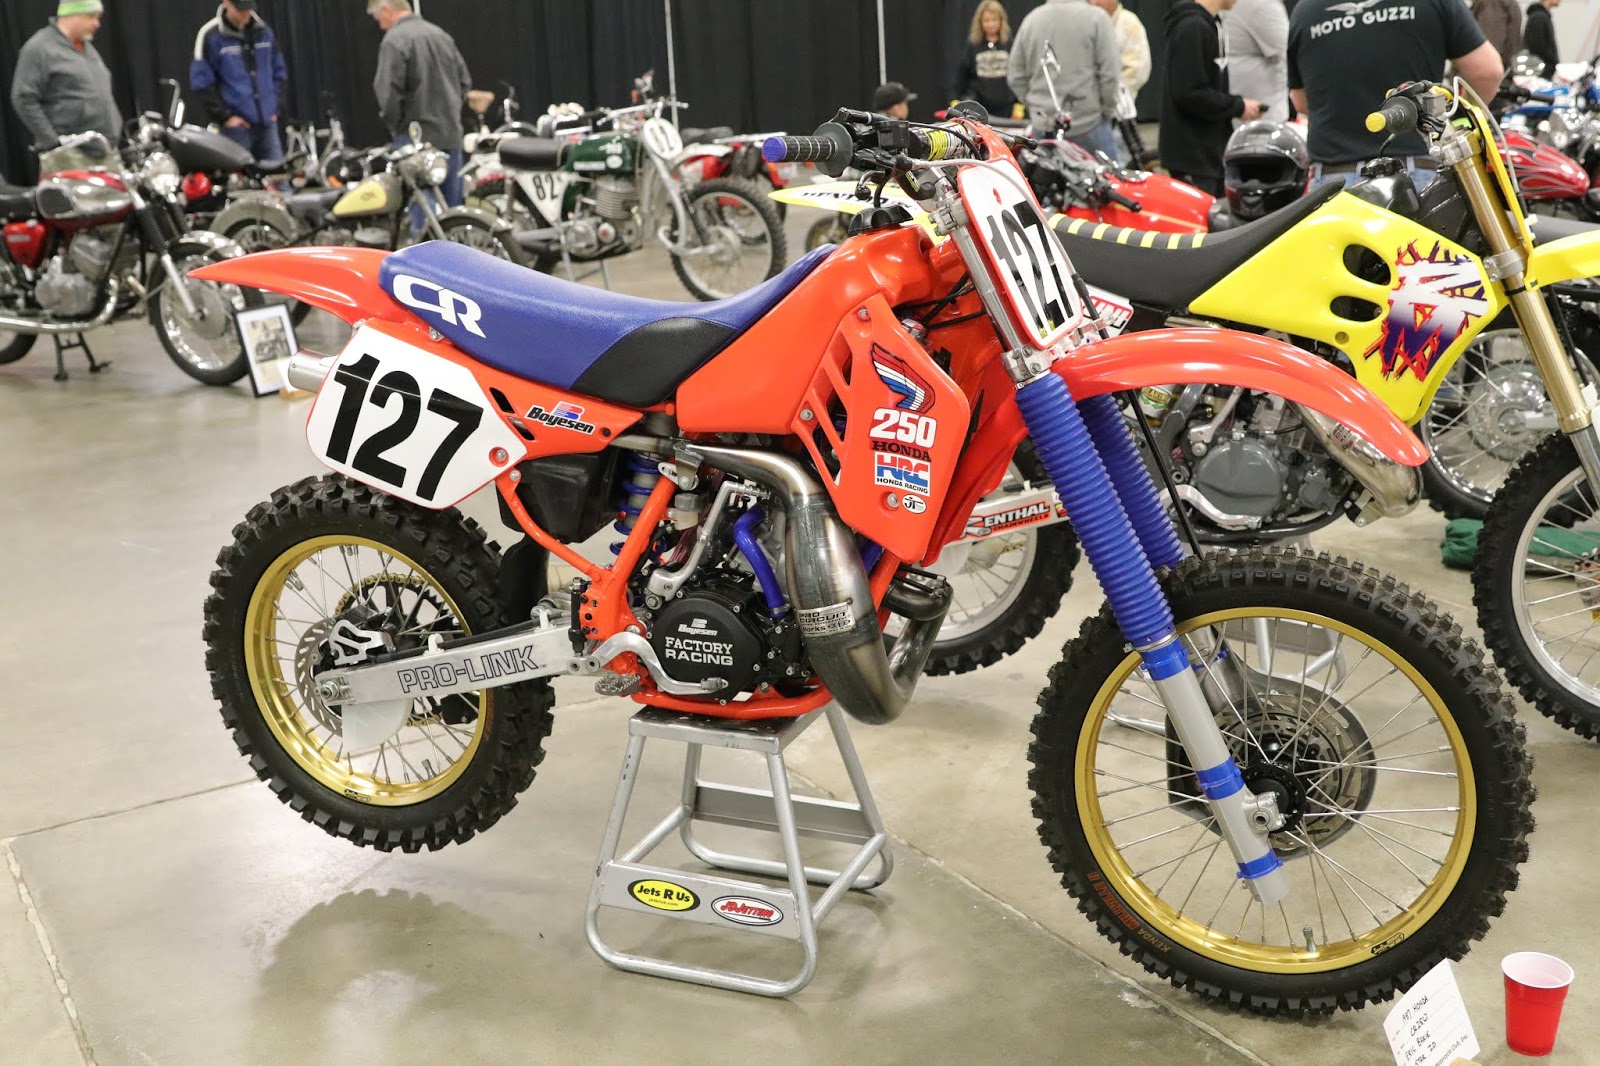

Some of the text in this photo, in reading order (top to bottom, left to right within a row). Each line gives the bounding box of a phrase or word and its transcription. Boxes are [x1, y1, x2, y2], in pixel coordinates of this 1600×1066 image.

[1310, 6, 1415, 39] MOTO GUZZI
[532, 173, 558, 200] 82
[986, 200, 1074, 339] 127
[393, 274, 487, 338] CR
[326, 353, 484, 501] 127
[526, 406, 595, 434] Boyesen
[869, 408, 937, 449] 250
[872, 440, 931, 462] HONDA
[877, 454, 929, 487] HRC
[876, 477, 928, 494] HONDA RACING
[678, 624, 718, 636] Boyesen
[665, 636, 733, 654] FACTORY
[665, 648, 733, 666] RACING
[397, 645, 539, 694] PRO-LINK
[637, 885, 690, 902] Jets R Us
[1138, 928, 1171, 953] KENDA
